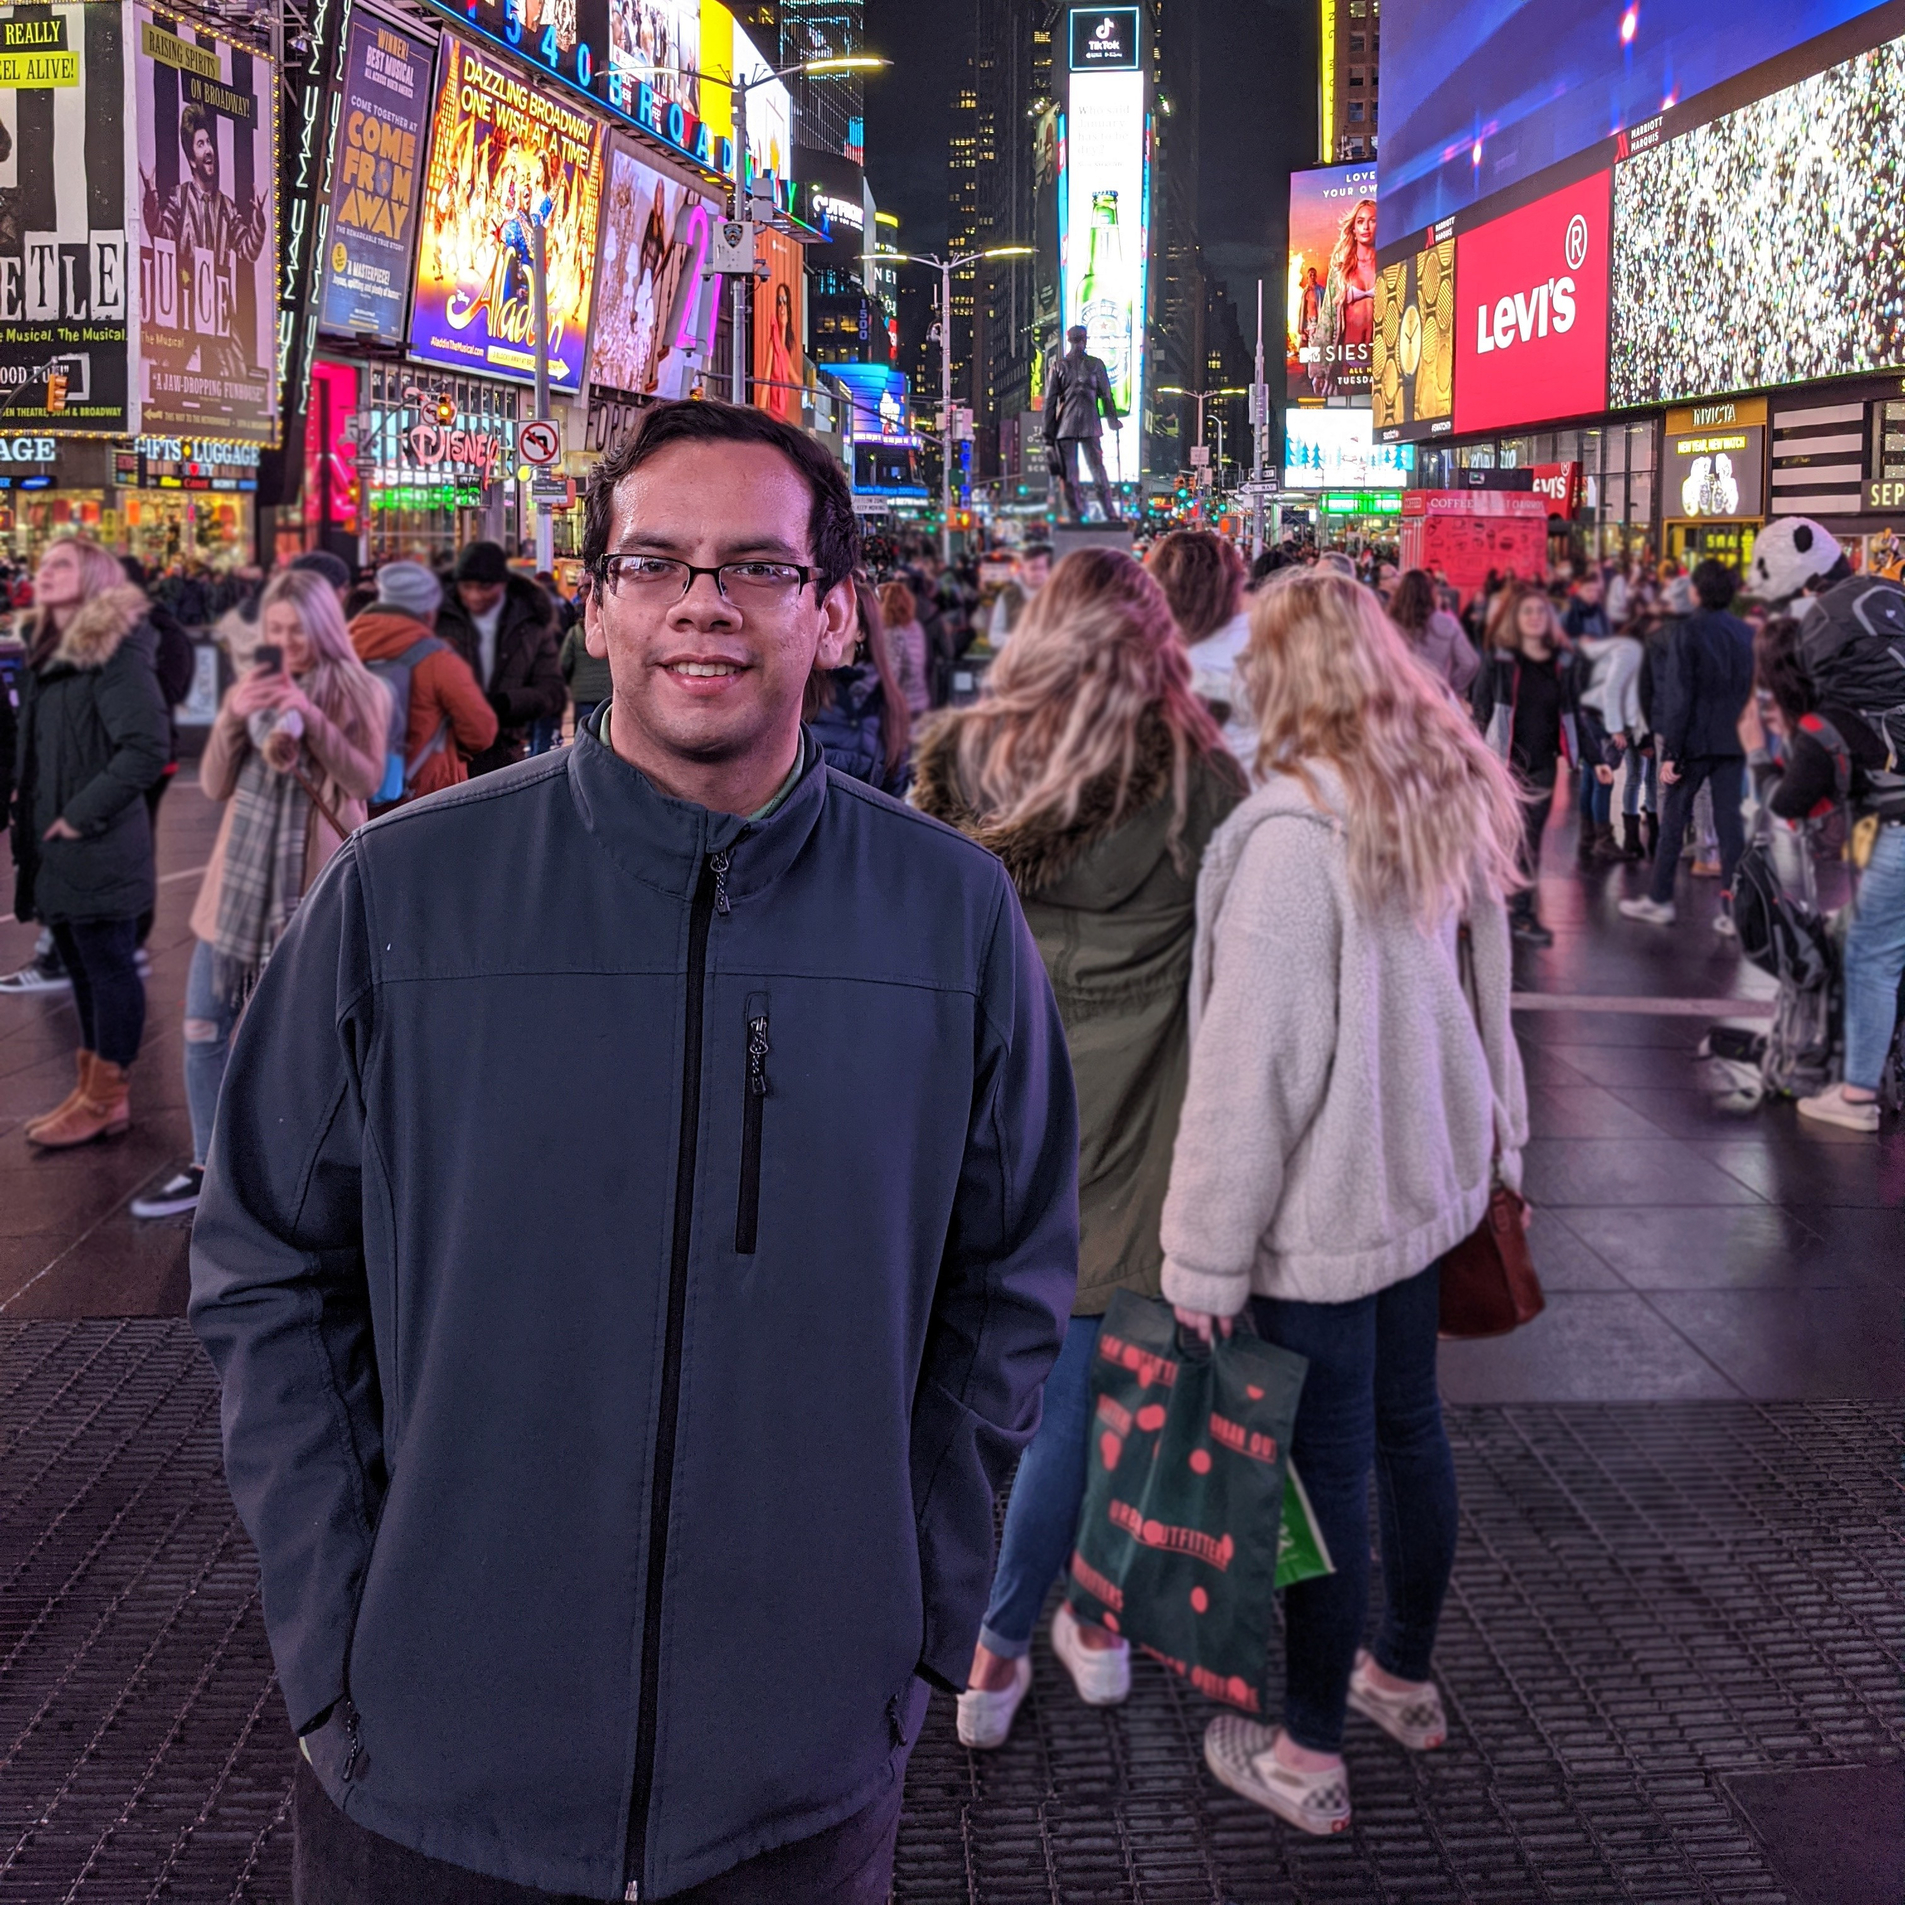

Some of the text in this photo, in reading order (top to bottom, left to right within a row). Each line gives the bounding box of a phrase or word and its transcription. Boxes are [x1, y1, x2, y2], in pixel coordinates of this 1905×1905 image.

[5, 21, 60, 45] REALLY
[378, 28, 409, 61] WINNER!
[149, 31, 216, 76] RAISING SPIRITS
[1088, 40, 1120, 51] TikTok
[0, 58, 73, 80] EL ALIVE!
[366, 45, 414, 87] BEST MUSICAL
[190, 79, 250, 118] ON BROADWAY!
[464, 56, 528, 111] DAZZLING
[529, 91, 593, 144] BROADWAY
[1078, 104, 1130, 115] Who said
[351, 95, 418, 132] COME TOGETHER AT
[1078, 118, 1126, 130] January
[348, 110, 416, 167] COME
[460, 85, 591, 171] ONE WISH AT A TIME!
[1078, 131, 1129, 141] has to be
[1631, 116, 1664, 140] MARRIOTT
[1077, 144, 1105, 157] dry?
[1631, 131, 1660, 152] MARQUIS
[1345, 171, 1376, 183] LOVE
[1323, 187, 1354, 198] YOUR
[337, 189, 409, 240] AWAY
[336, 224, 345, 235] THE
[859, 298, 868, 341] 1500
[57, 327, 80, 342] The
[141, 331, 154, 345] The
[1349, 367, 1363, 375] ALL
[80, 407, 122, 417] BROADWAY
[1692, 403, 1737, 427] INVICTA
[134, 437, 260, 467] GIFTS LUGGAGE
[1430, 498, 1474, 509] COFFEE
[1870, 482, 1905, 507] SEP
